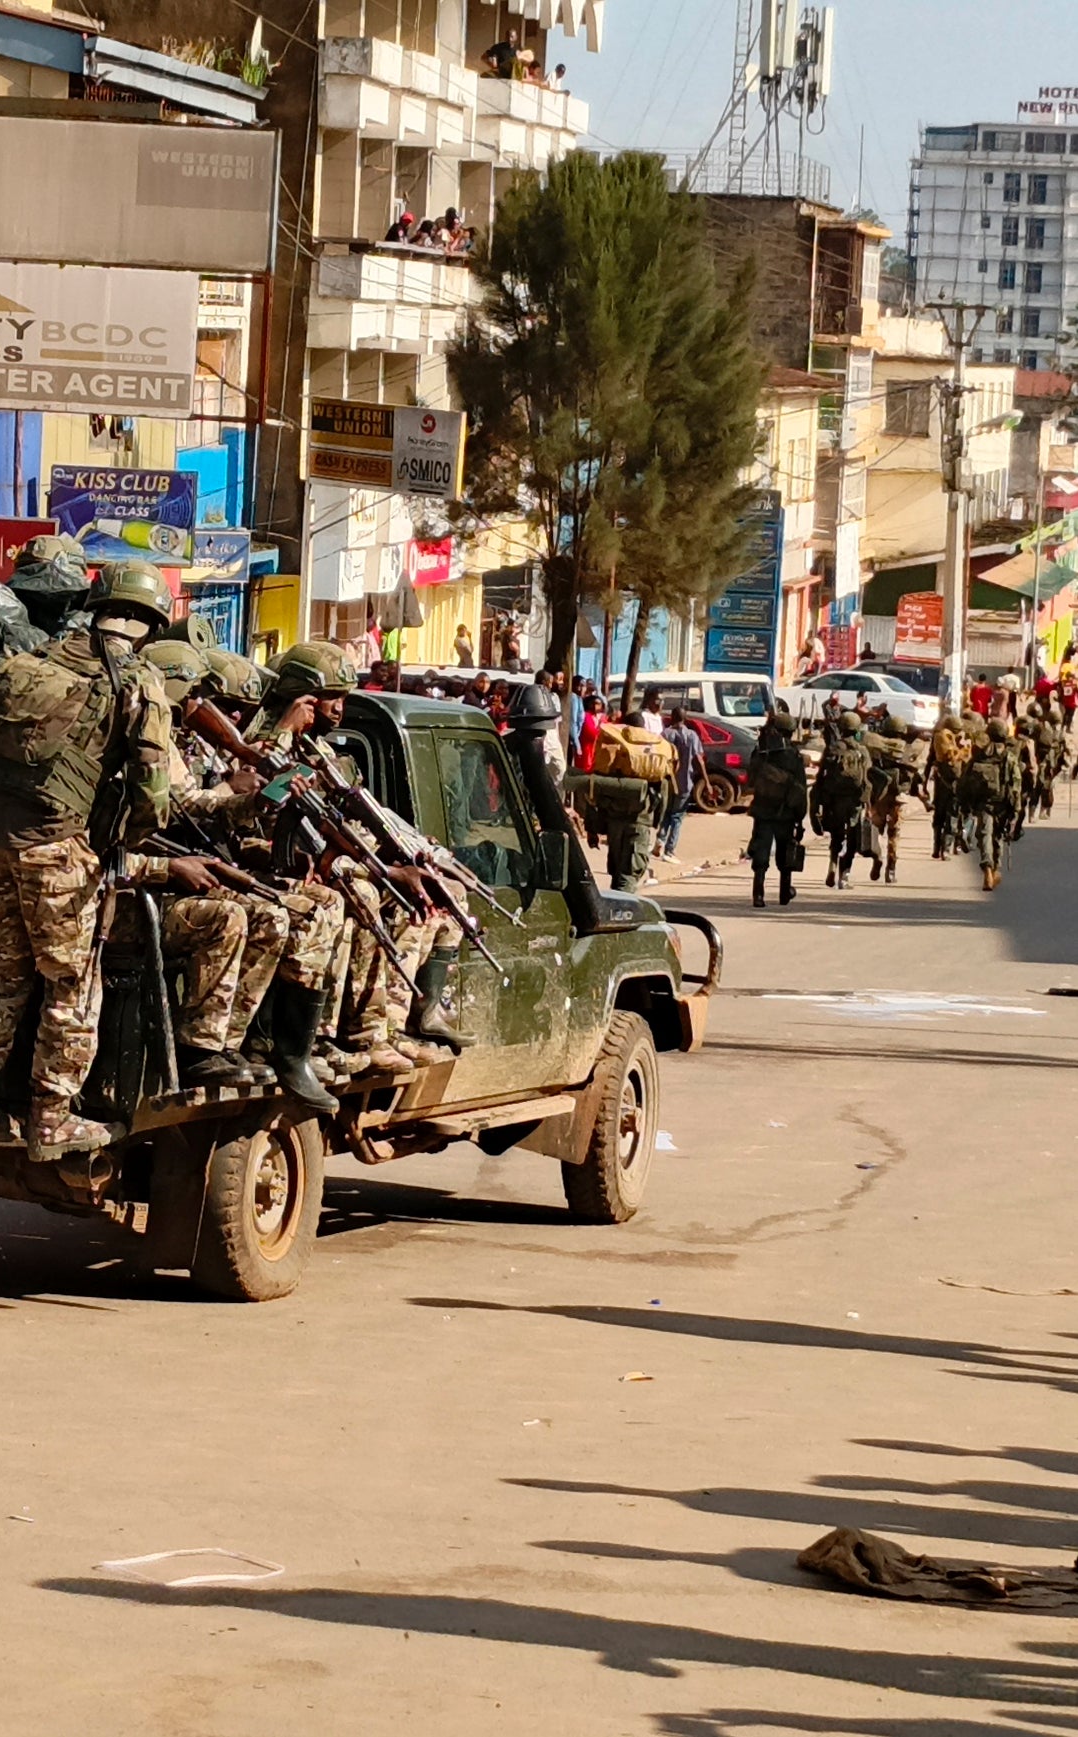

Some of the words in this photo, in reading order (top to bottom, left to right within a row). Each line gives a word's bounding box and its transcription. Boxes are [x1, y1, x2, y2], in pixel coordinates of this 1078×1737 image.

[1018, 101, 1053, 113] NEW
[151, 151, 249, 168] WESTERN
[181, 165, 249, 179] UNION
[41, 320, 169, 348] BCDC
[64, 373, 186, 401] AGENT
[313, 405, 382, 423] WESTERN
[334, 420, 382, 436] UNION
[315, 454, 341, 467] CASH
[342, 457, 387, 473] EXPRESS
[409, 458, 451, 484] SMICO
[74, 472, 116, 490] KISS
[120, 474, 171, 492] CLUB
[114, 506, 151, 517] CLASS
